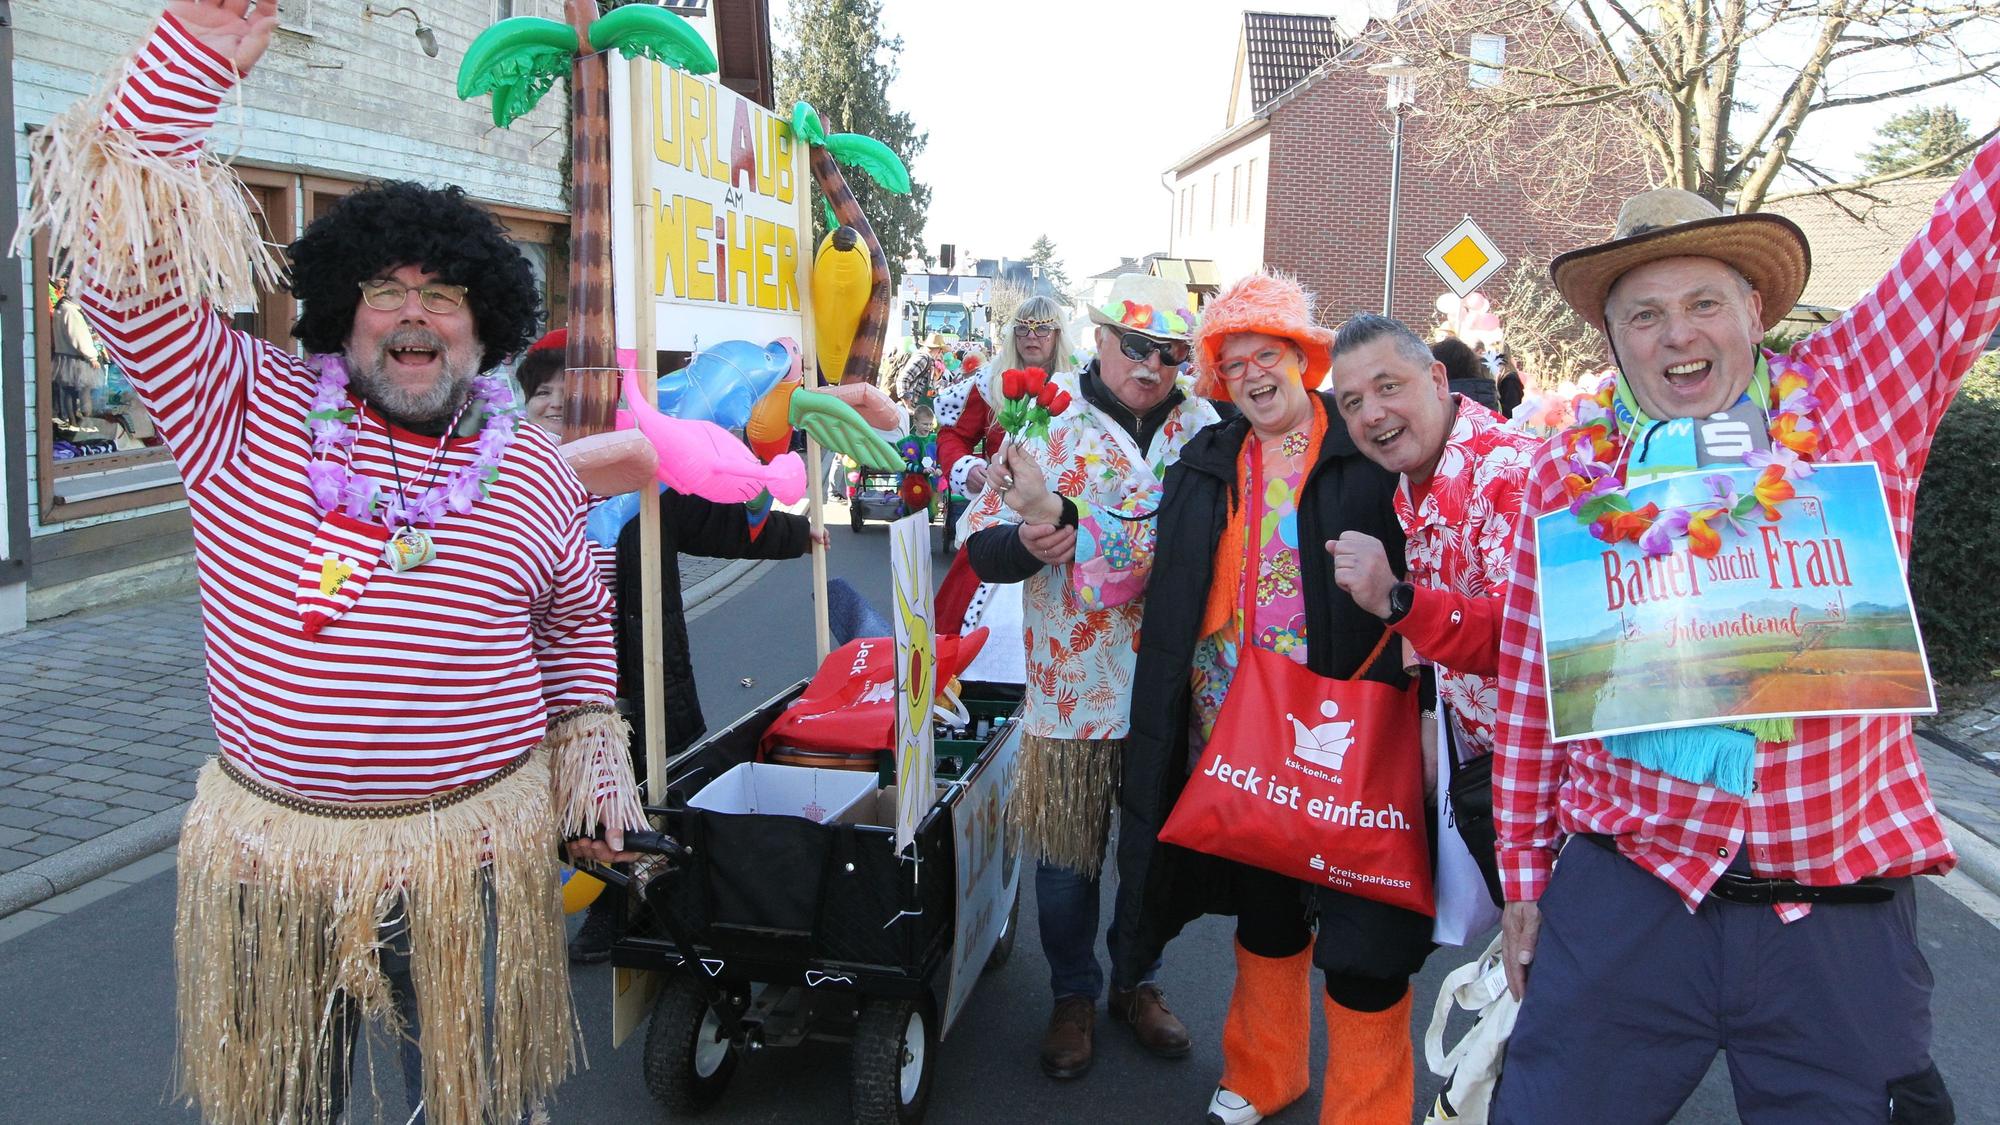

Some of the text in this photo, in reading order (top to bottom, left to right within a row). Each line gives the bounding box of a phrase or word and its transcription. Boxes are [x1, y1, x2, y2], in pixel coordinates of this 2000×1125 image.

[652, 60, 795, 206] URLAUB
[724, 186, 744, 211] AM
[1707, 545, 1760, 583] sucht
[1758, 525, 1853, 590] Frau
[1663, 606, 1804, 649] International
[849, 641, 874, 676] Jeck
[1285, 757, 1343, 785] ksk-koeln.de
[1204, 754, 1411, 830] Jeck ist einfach.
[1328, 875, 1353, 888] Köln
[1329, 865, 1411, 889] Kreissparkasse
